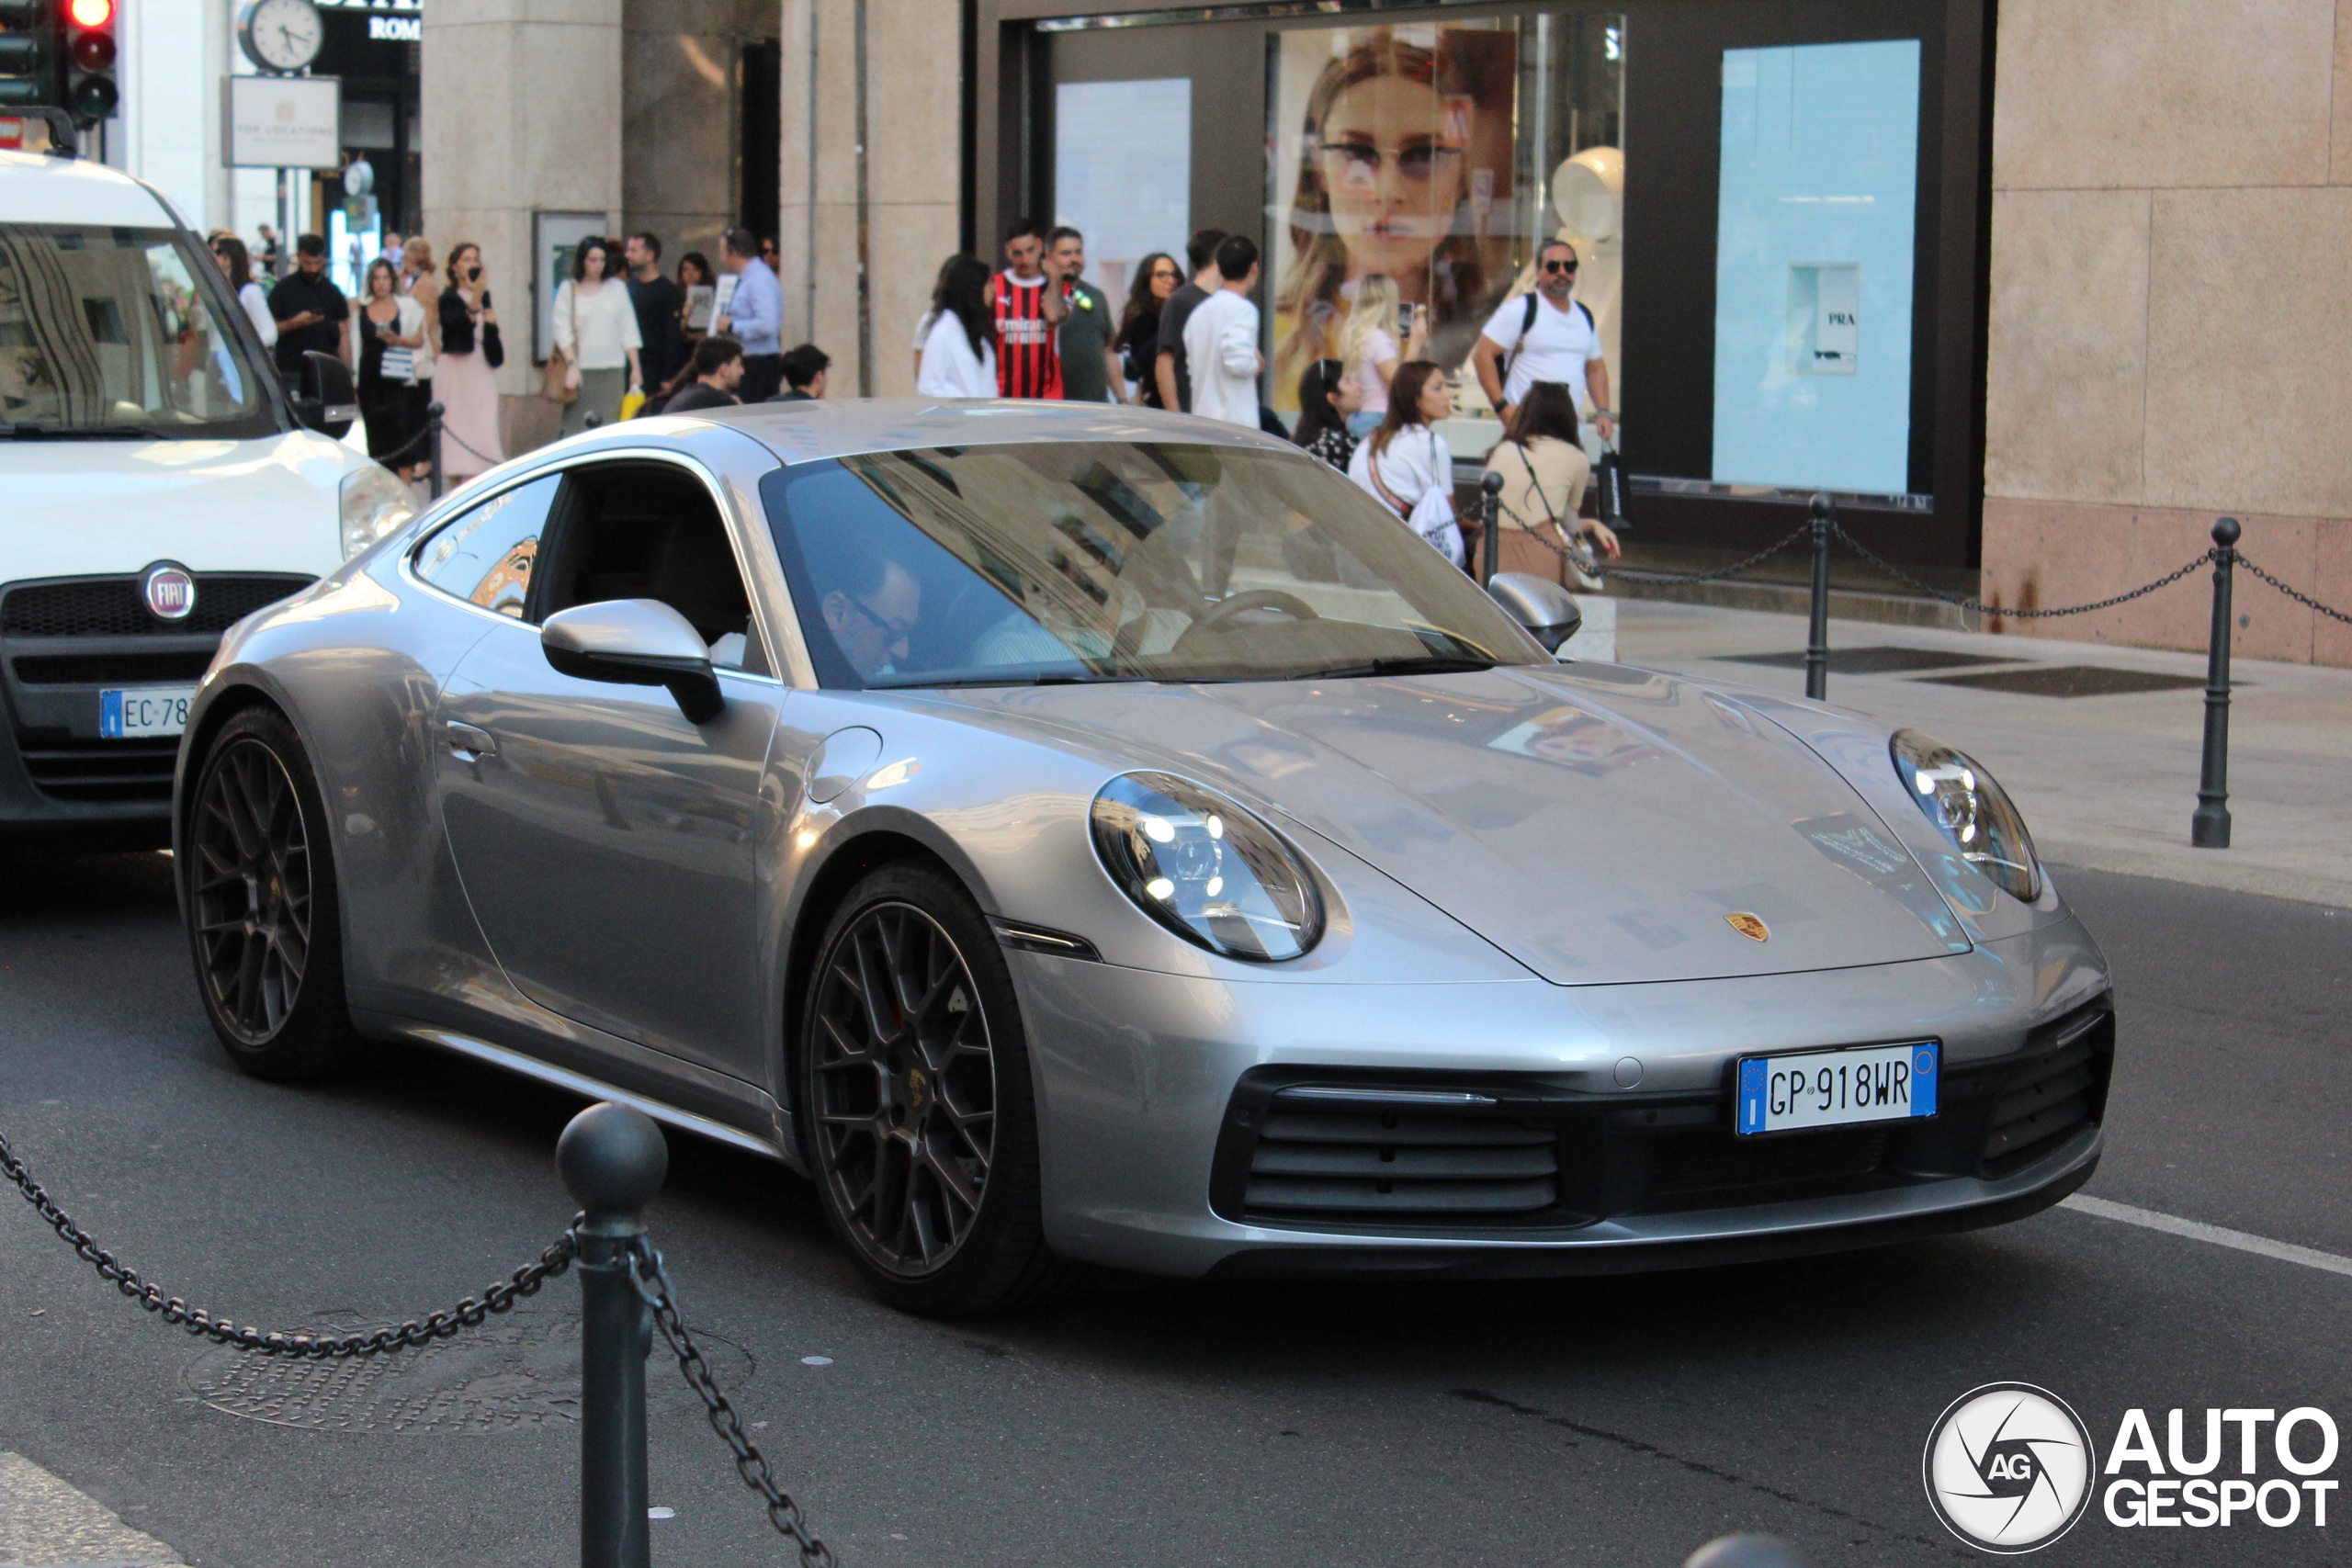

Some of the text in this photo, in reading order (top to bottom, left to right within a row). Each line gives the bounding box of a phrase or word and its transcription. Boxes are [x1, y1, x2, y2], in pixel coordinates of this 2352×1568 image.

[1828, 312, 1855, 325] PRA
[157, 583, 184, 605] FIAT
[160, 698, 194, 727] 78
